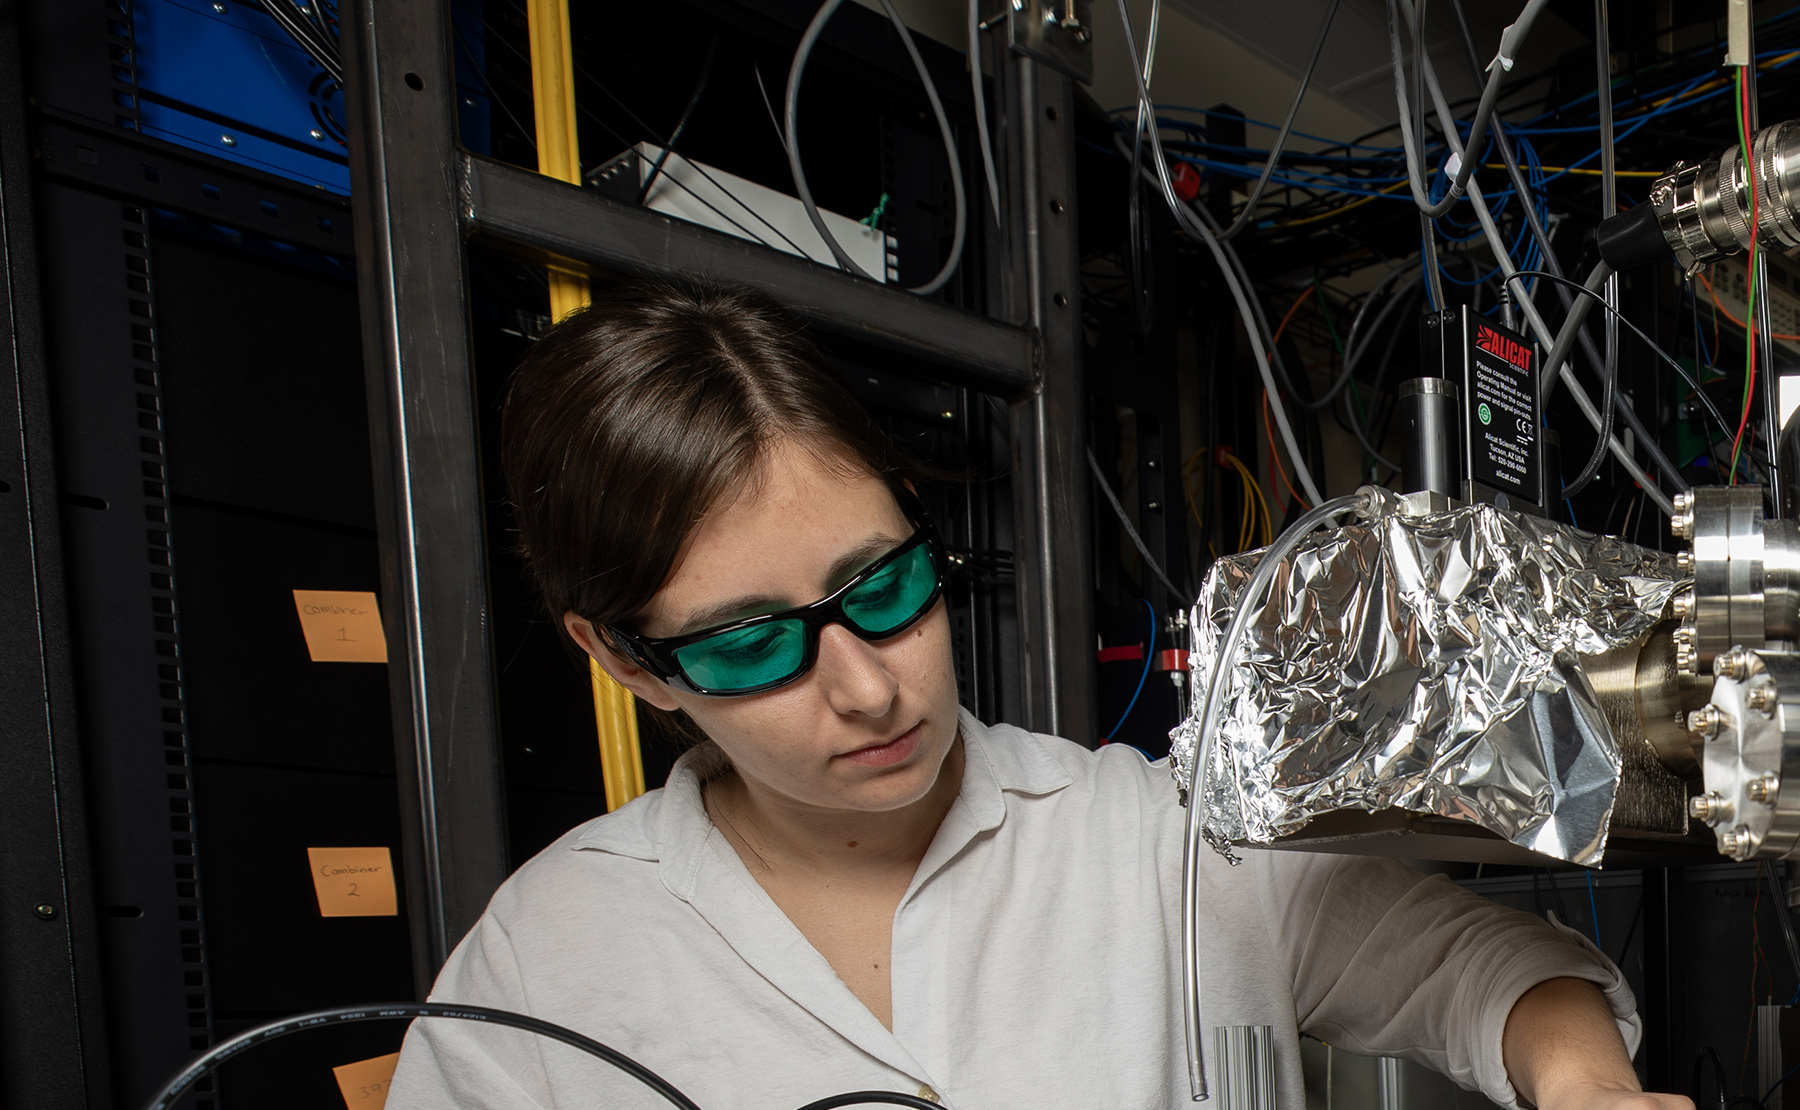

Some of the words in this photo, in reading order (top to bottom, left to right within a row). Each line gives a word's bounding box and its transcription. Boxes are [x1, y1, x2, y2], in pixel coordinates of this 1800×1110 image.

[1491, 332, 1532, 371] ALICAT
[1476, 360, 1492, 374] Please
[1492, 370, 1510, 382] consult
[1477, 370, 1500, 389] Operating
[1500, 381, 1517, 395] Manual
[1477, 381, 1501, 397] alicat.com
[1477, 391, 1492, 402] power
[1491, 397, 1500, 406] and
[1500, 401, 1514, 413] signal
[1485, 432, 1499, 444] Alicat
[1490, 443, 1508, 458] Tucson,
[1507, 451, 1515, 460] AZ
[1514, 454, 1526, 465] USA
[1495, 469, 1521, 486] alicat.com
[347, 882, 361, 898] 2
[379, 1009, 405, 1018] AWM
